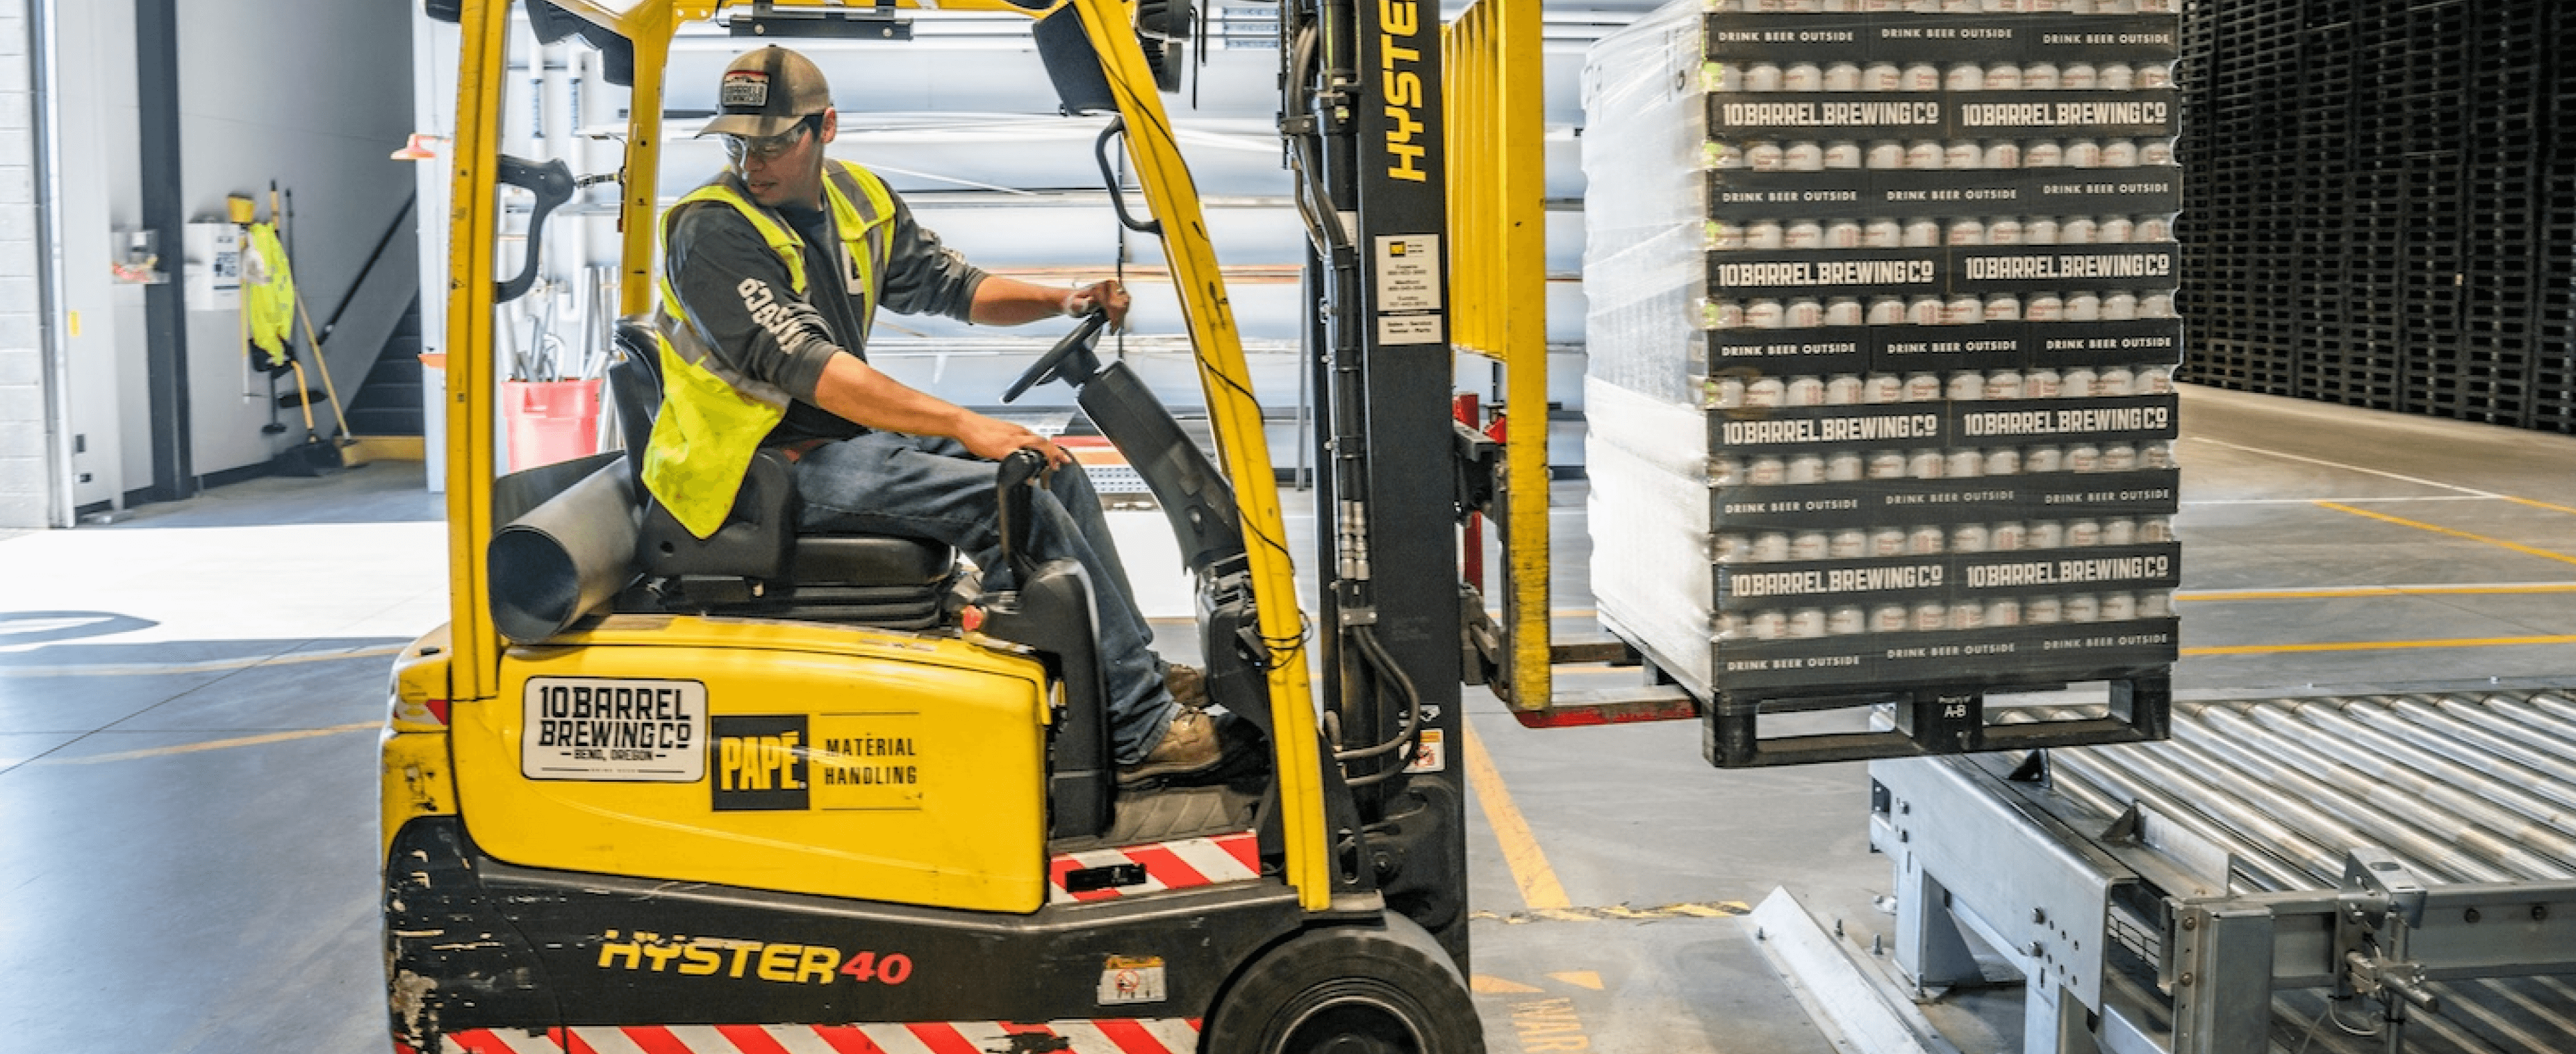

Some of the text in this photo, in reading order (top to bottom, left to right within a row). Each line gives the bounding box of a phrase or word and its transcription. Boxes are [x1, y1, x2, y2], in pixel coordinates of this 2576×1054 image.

[1719, 31, 1852, 41] DRINK BEER OUTSIDE
[1882, 28, 2012, 39] DRINK BEER OUTSIDE
[2044, 33, 2168, 44] DRINK BEER OUTSIDE
[1379, 0, 1426, 183] HYSTE
[1887, 188, 2015, 201] DRINK BEER OUTSIDE
[2044, 183, 2168, 194] DRINK BEER OUTSIDE
[1723, 190, 1856, 203] DRINK BEER OUTSIDE
[1722, 342, 1854, 356] DRINK BEER OUTSIDE
[1887, 340, 2016, 355] DRINK BEER OUTSIDE
[2046, 337, 2170, 350] DRINK BEER OUTSIDE
[1886, 490, 2013, 505] DRINK BEER OUTSIDE
[2046, 488, 2168, 504] DRINK BEER OUTSIDE
[1725, 498, 1856, 514] DRINK BEER OUTSIDE
[2044, 633, 2166, 651] DRINK BEER OUTSIDE
[1887, 643, 2014, 660] DRINK BEER OUTSIDE
[1728, 655, 1858, 671] DRINK BEER OUTSIDE
[1944, 705, 1967, 717] A-B
[610, 749, 653, 760] OREGON
[720, 730, 800, 790] PAPÉ
[825, 766, 918, 785] HANDLING
[597, 929, 913, 985] HYSTER 40
